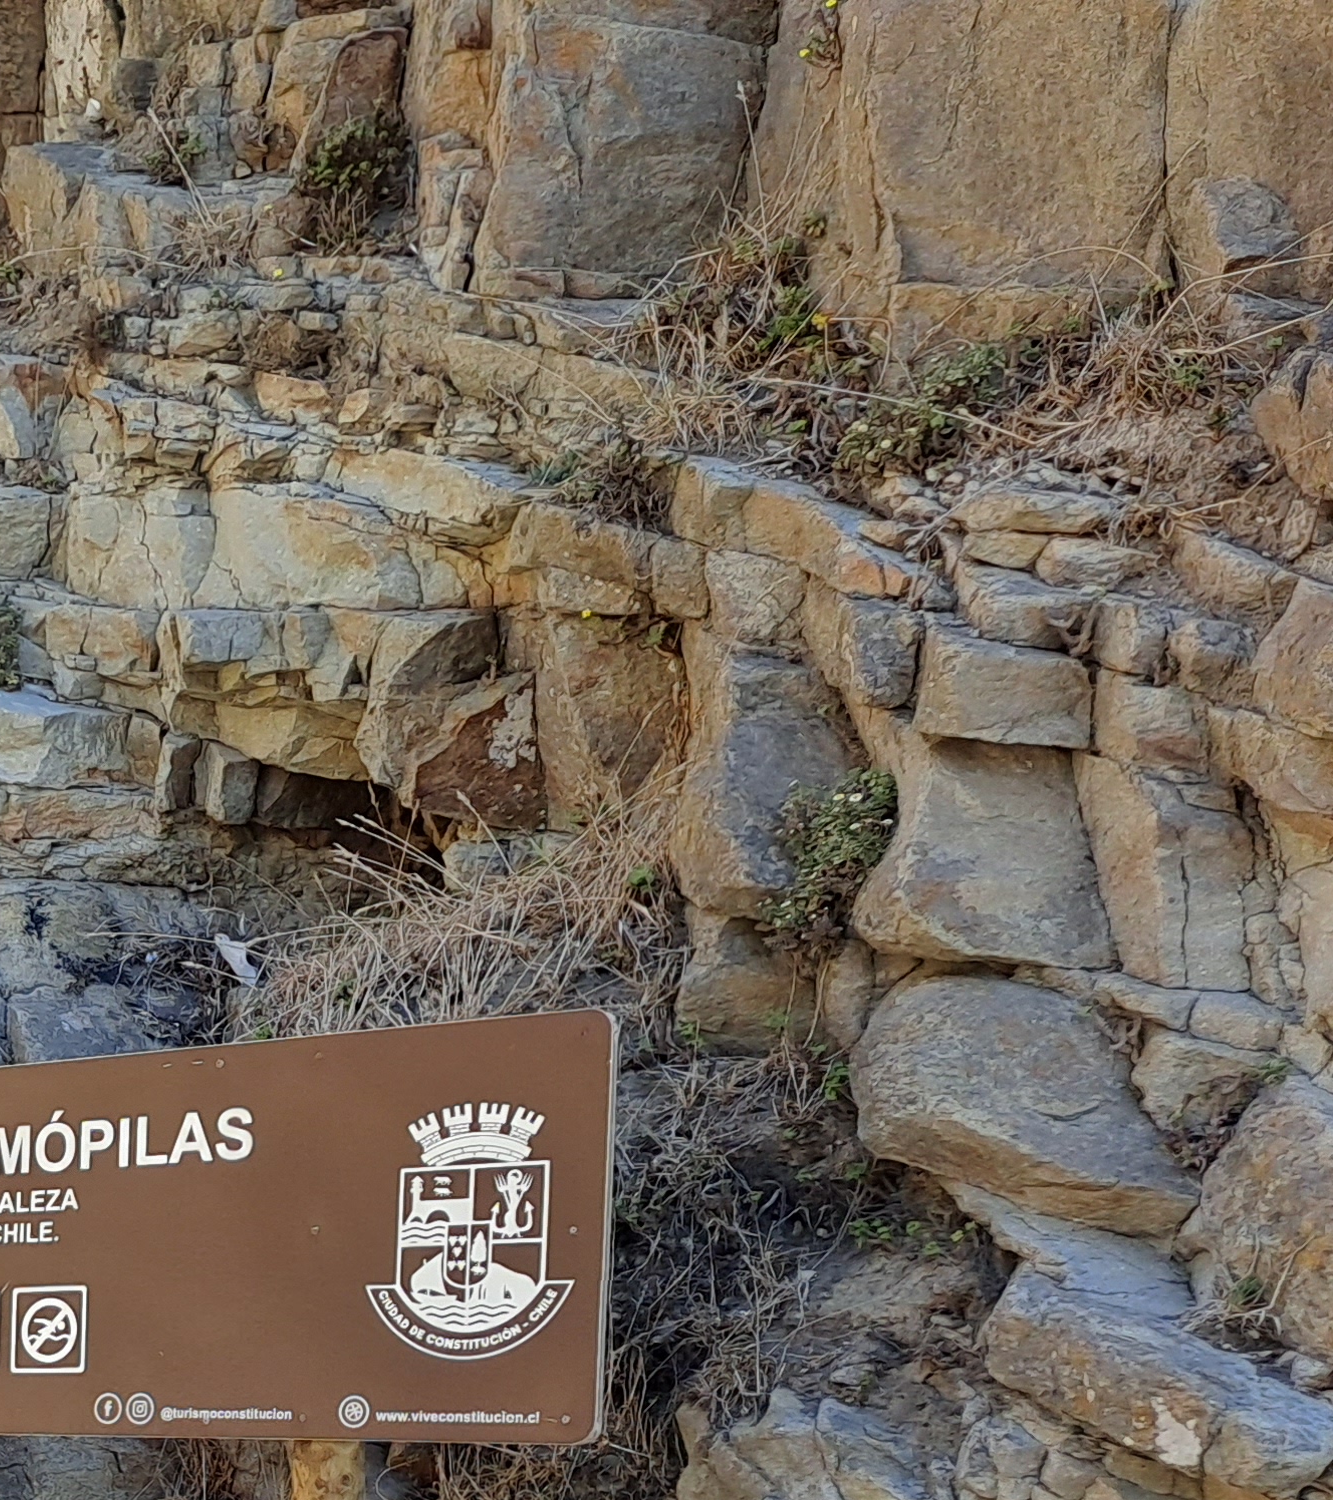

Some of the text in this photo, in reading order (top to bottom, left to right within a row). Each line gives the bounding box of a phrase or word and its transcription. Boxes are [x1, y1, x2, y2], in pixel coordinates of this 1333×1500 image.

[379, 1290, 409, 1329] CIUDAD
[409, 1326, 424, 1340] DE
[426, 1324, 521, 1349] CONSTITUCIÓN
[529, 1289, 557, 1322] CHILE
[160, 1406, 293, 1424] @turismoconstitucion
[375, 1410, 540, 1424] www.viveconstitucion.cl
